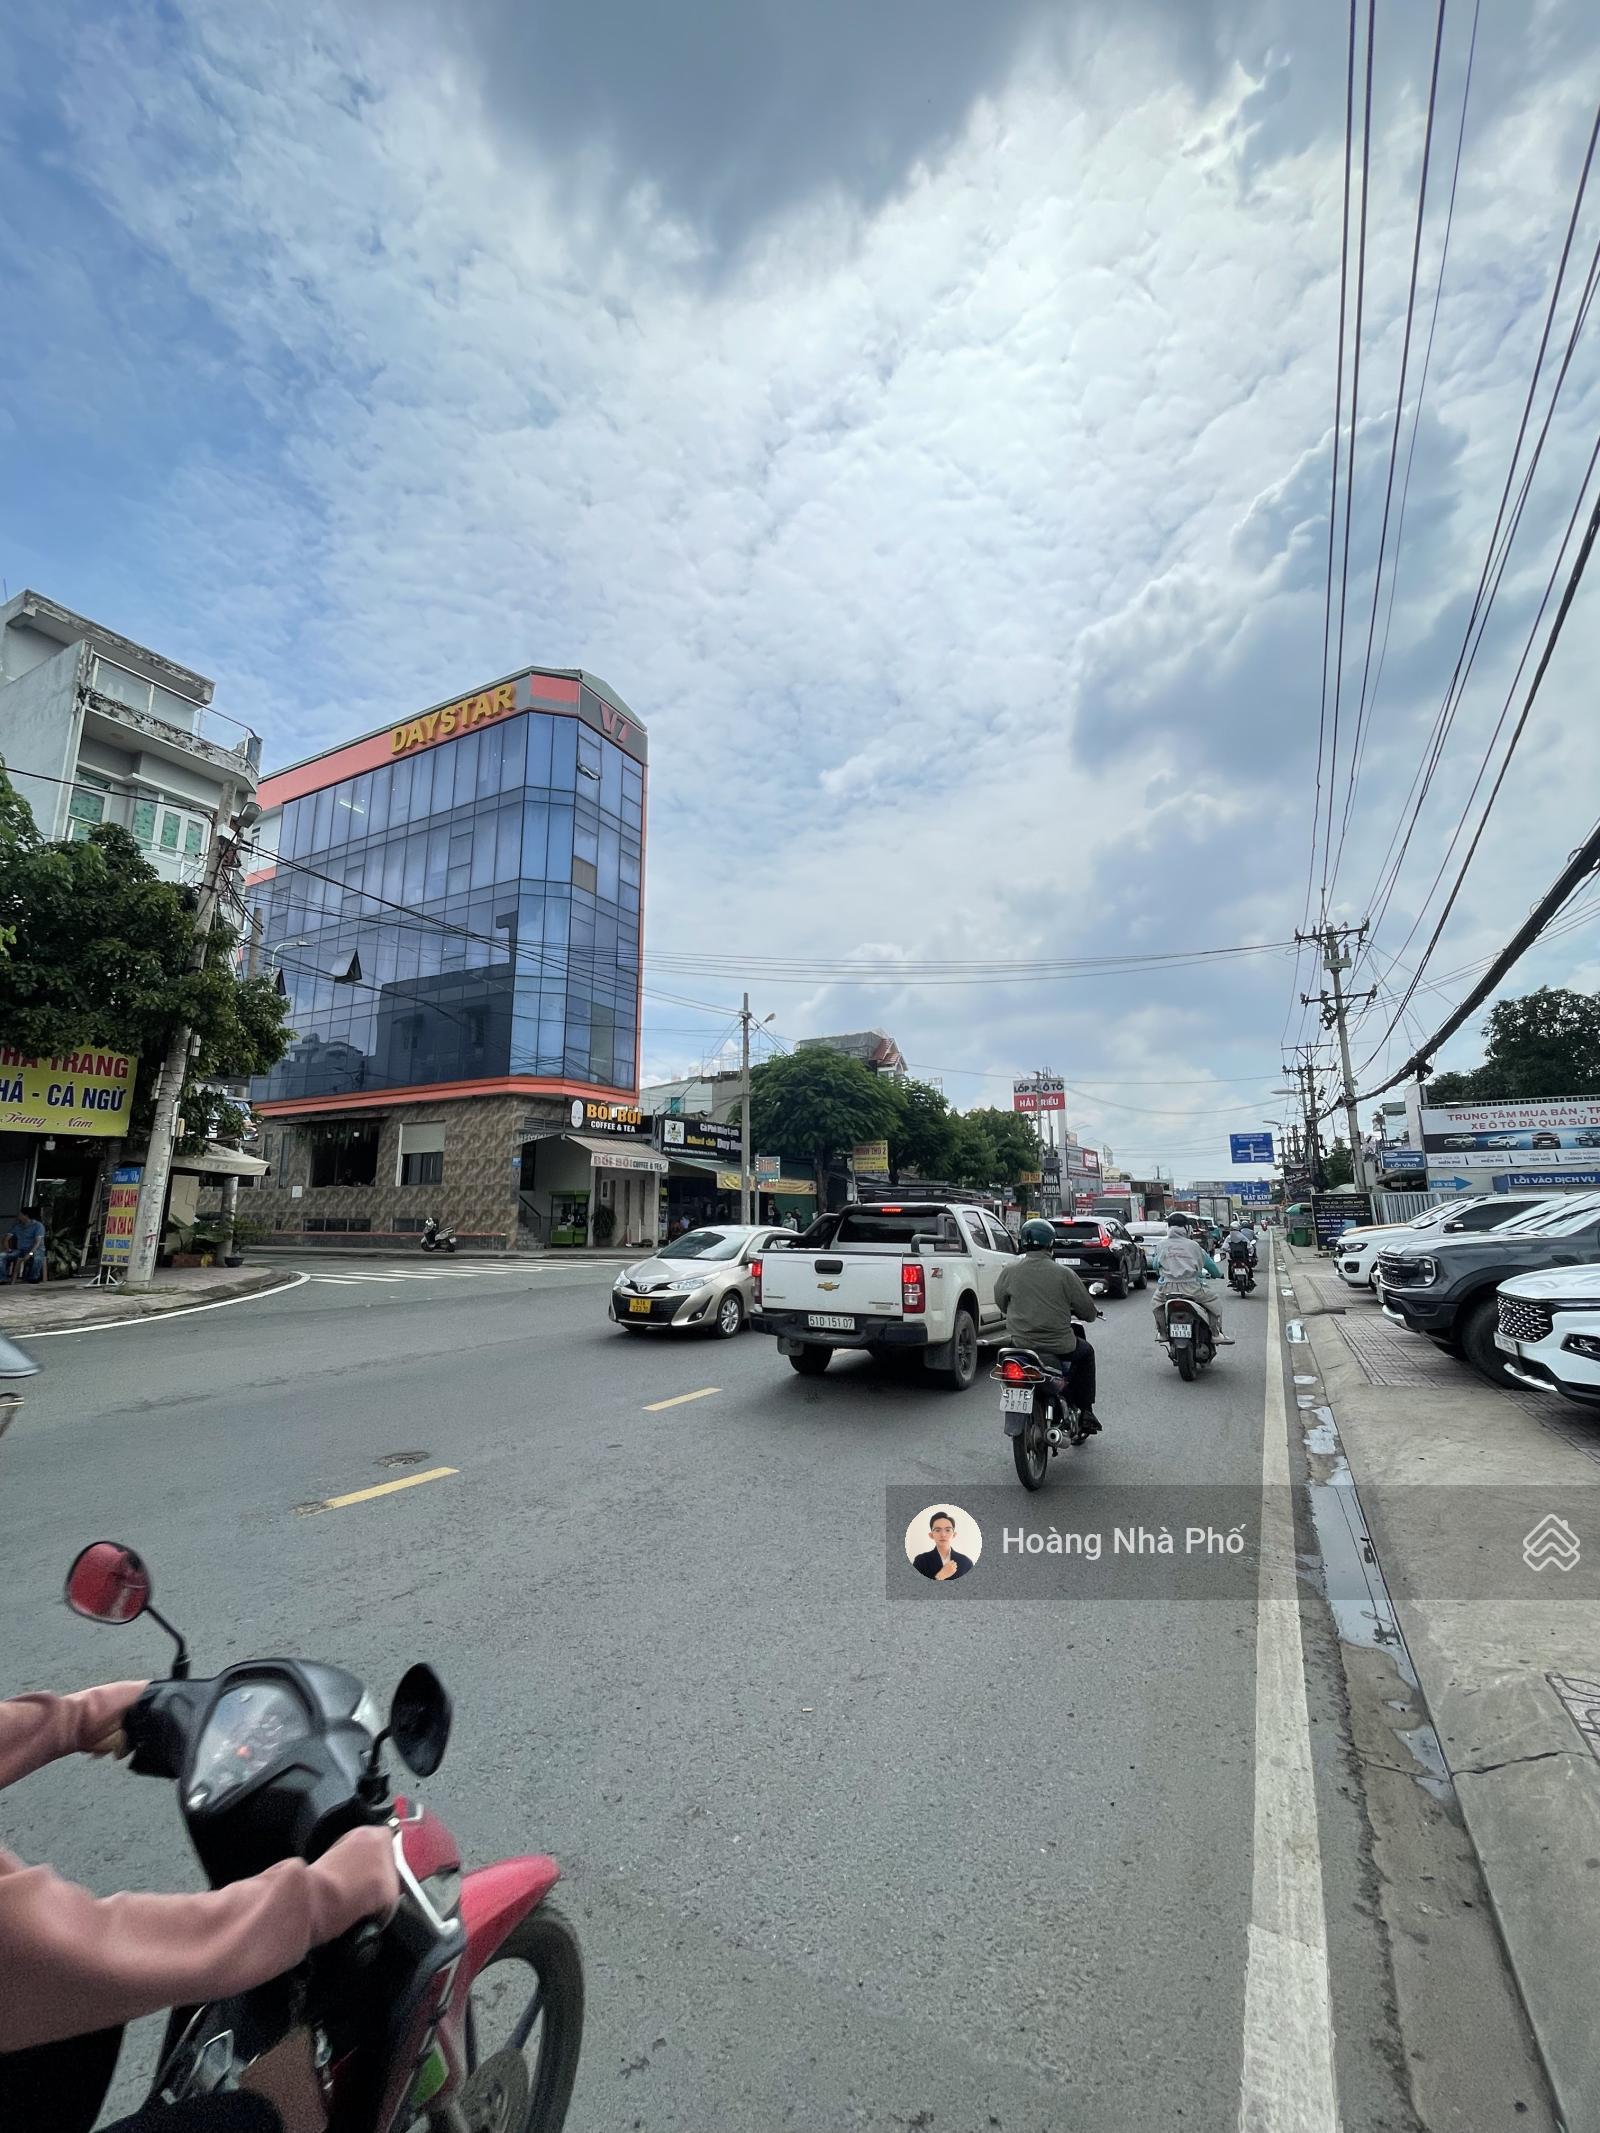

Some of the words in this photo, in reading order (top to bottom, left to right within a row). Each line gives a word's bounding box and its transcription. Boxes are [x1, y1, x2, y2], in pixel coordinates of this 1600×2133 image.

[392, 684, 515, 755] DAYSTAR
[0, 1047, 39, 1069] HA
[47, 1081, 75, 1107] CÁ
[82, 1086, 127, 1111] NGỪ
[1448, 1113, 1488, 1121] TRUNG
[1490, 1110, 1517, 1119] TÂM
[1519, 1109, 1547, 1118] MUA
[1551, 1106, 1577, 1116] BÁN
[591, 1121, 615, 1131] COFFEE
[623, 1124, 636, 1133] TEA
[1472, 1121, 1486, 1130] XE
[1489, 1119, 1498, 1129] Ô
[1501, 1118, 1517, 1128] TÔ
[1519, 1118, 1536, 1128] ĐÃ
[1539, 1118, 1566, 1128] QUA
[1044, 1175, 1058, 1184] NHA
[1531, 1174, 1552, 1184] VÀO
[1555, 1176, 1579, 1184] DỊCH
[1580, 1176, 1596, 1184] VỤ
[1042, 1185, 1060, 1194] KHOA
